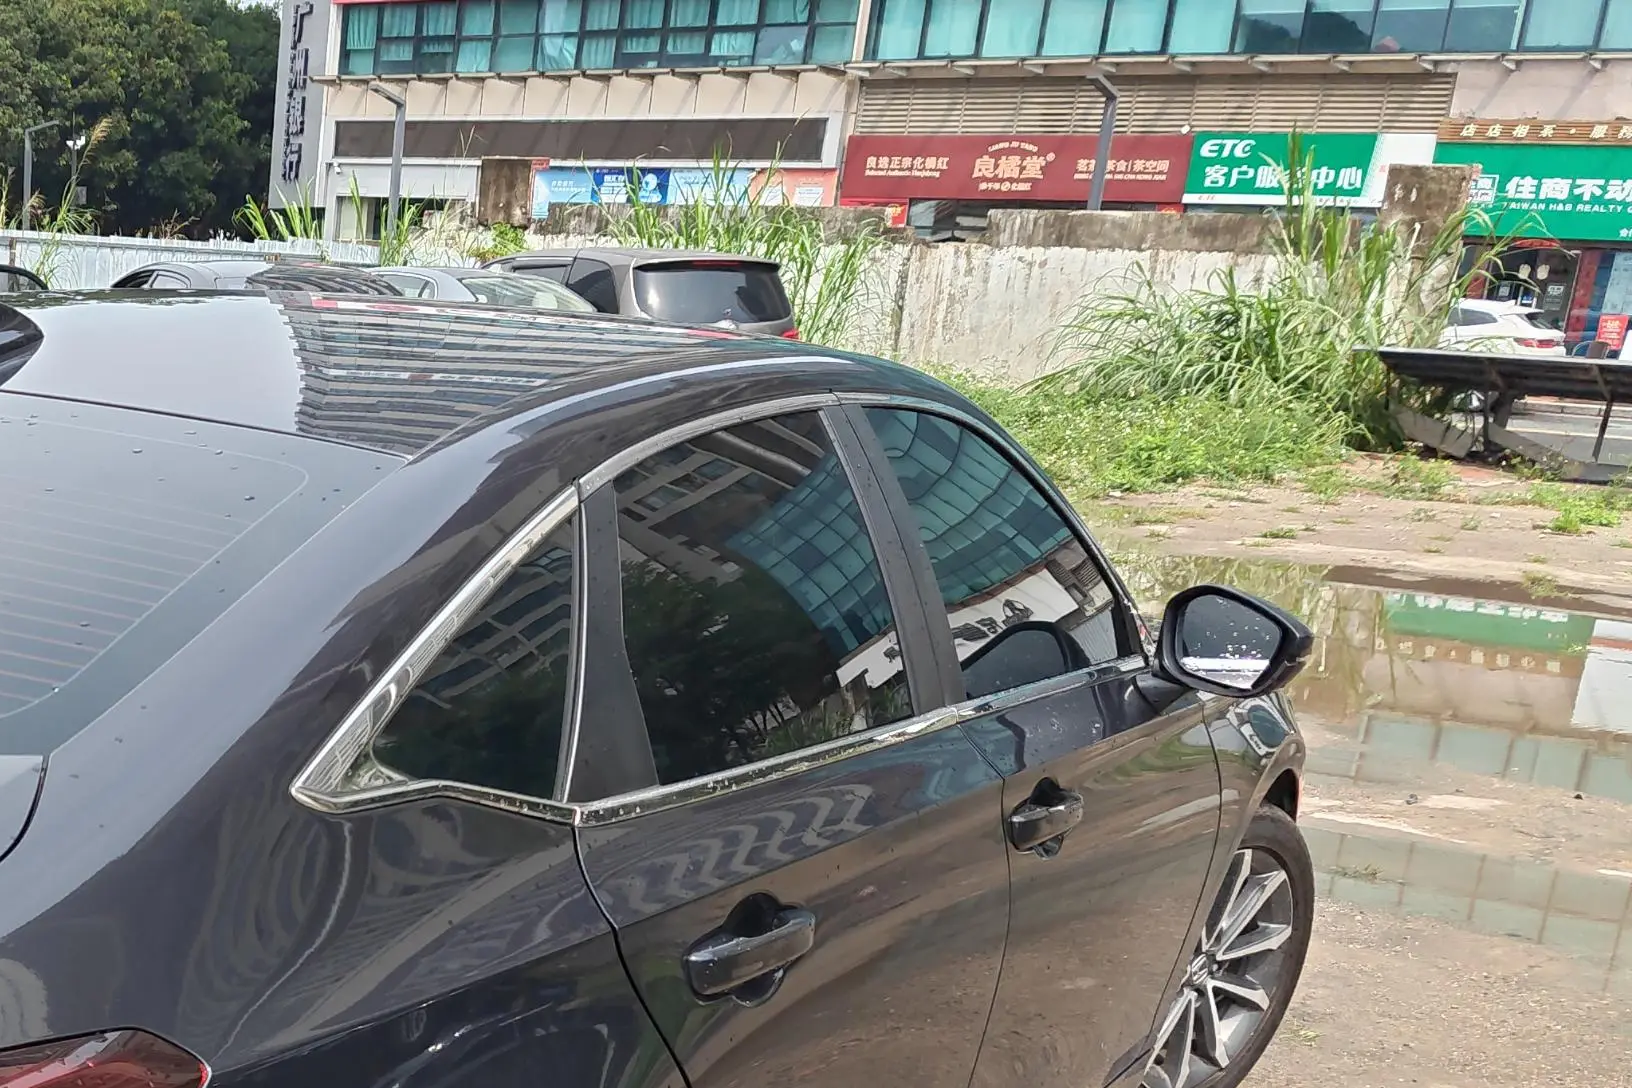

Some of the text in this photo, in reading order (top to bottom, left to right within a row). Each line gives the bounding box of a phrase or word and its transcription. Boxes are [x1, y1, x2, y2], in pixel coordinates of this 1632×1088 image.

[1200, 139, 1256, 158] ETC
[972, 155, 1046, 179] 良橘堂
[1549, 203, 1573, 211] H&B
[1576, 203, 1622, 212] REALTY
